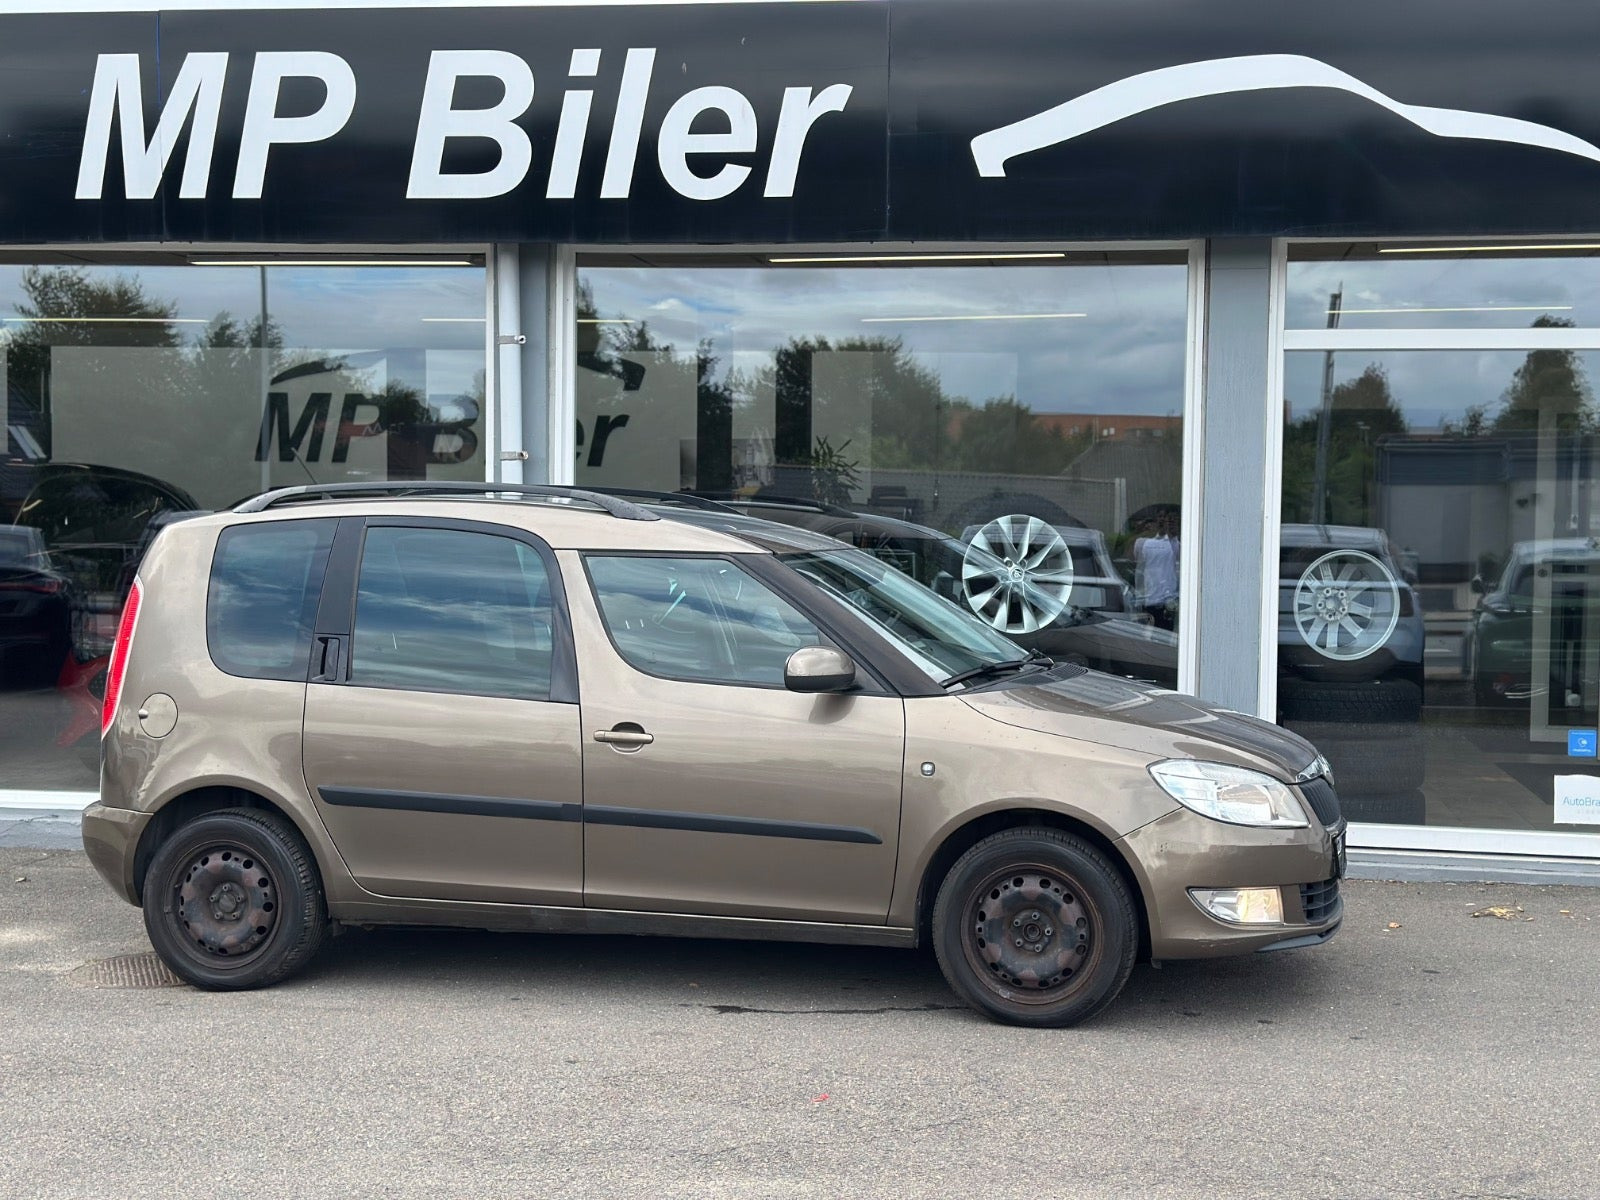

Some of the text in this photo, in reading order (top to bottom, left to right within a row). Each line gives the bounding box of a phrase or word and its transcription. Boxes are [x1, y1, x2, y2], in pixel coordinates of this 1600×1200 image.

[75, 48, 854, 201] MP Biler
[255, 392, 388, 463] MP
